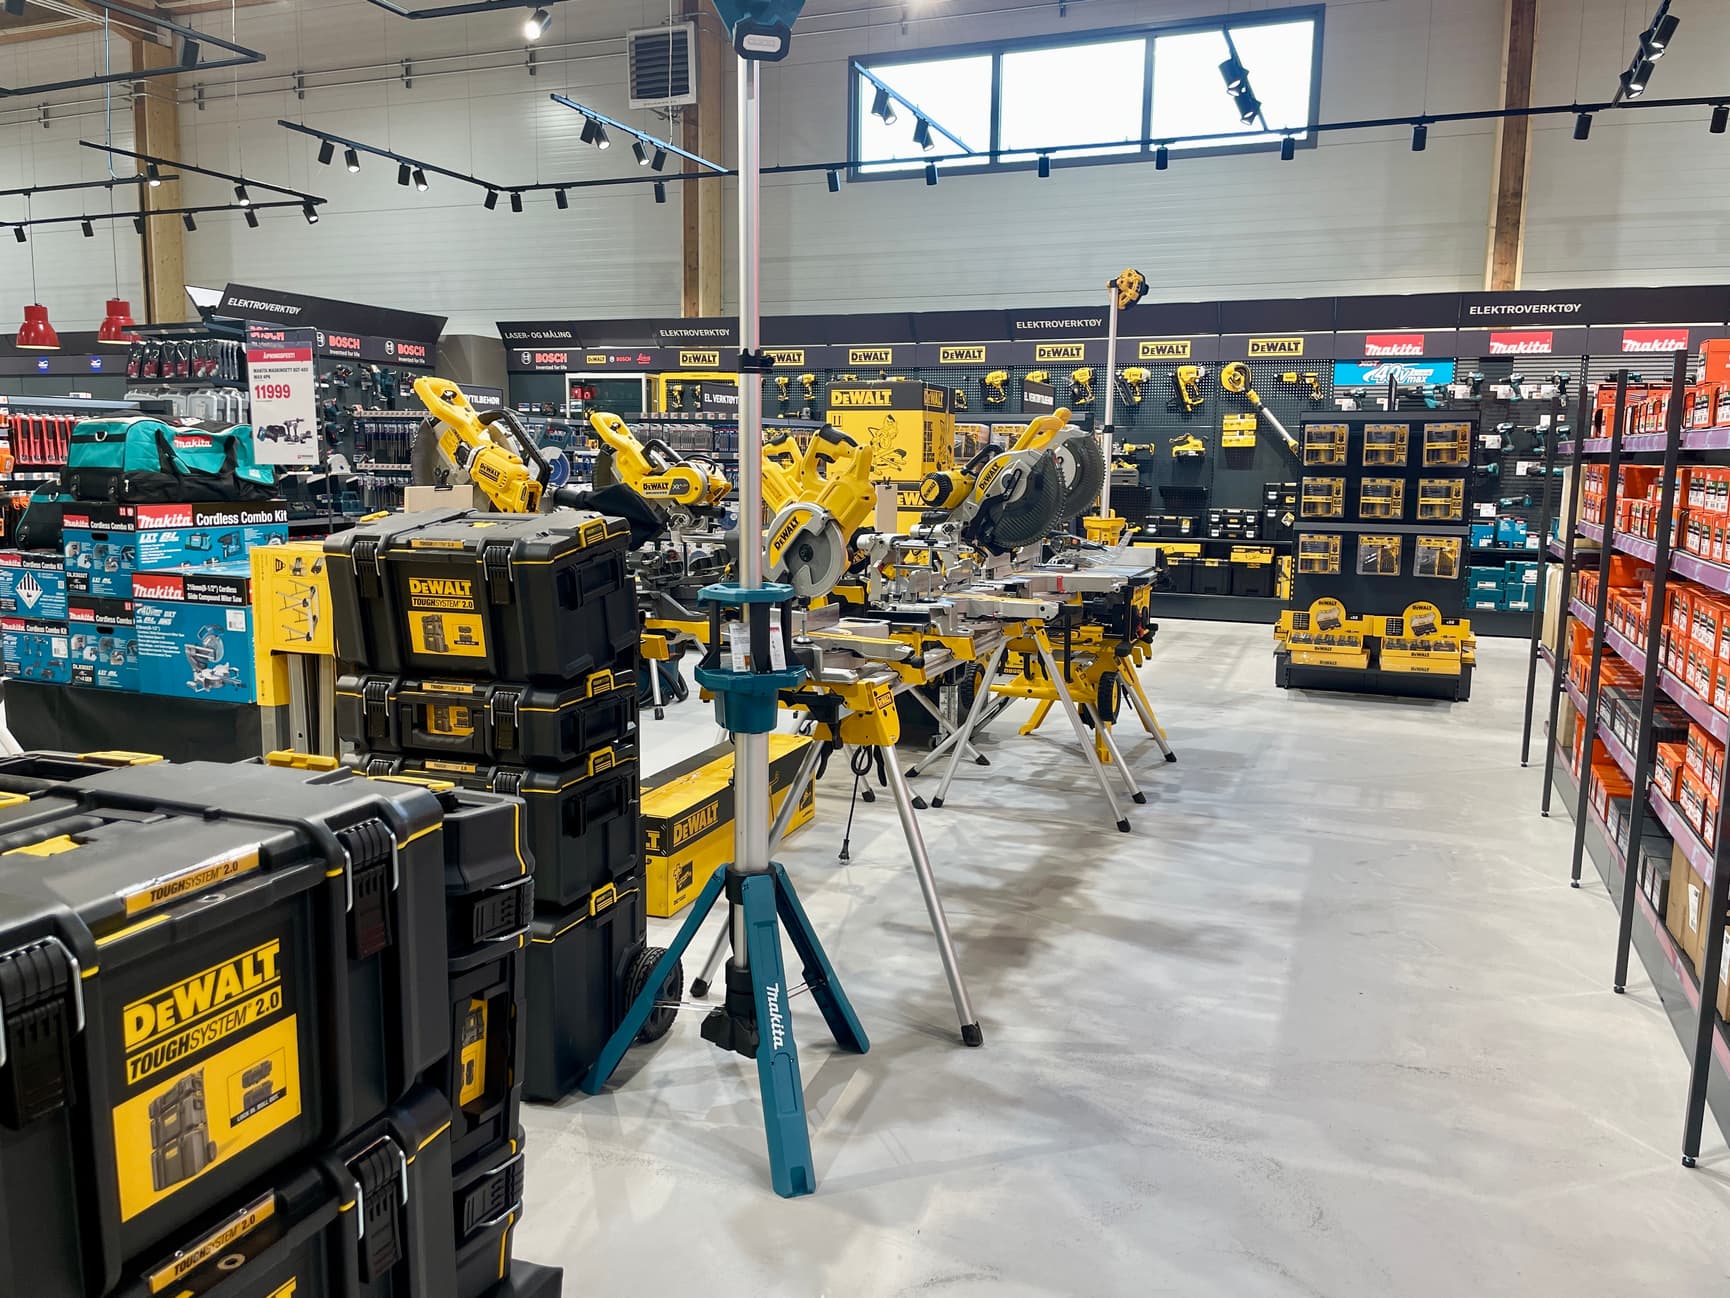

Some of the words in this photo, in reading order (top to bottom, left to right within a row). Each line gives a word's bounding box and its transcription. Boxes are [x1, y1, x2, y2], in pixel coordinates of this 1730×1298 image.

[227, 297, 301, 315] ELEKTROVERKTØY
[1469, 302, 1581, 315] ELEKTROVERKTØY
[1016, 319, 1102, 329] ELEKTROVERKTØY
[543, 330, 572, 338] MÅLING
[659, 329, 730, 337] ELEKTROVERKTØY
[329, 335, 361, 350] BOSCH
[1252, 341, 1301, 352] DEWALT
[1365, 342, 1424, 356] makita
[1490, 339, 1552, 354] makita
[1623, 337, 1689, 352] makita
[397, 343, 425, 357] BOSCH
[942, 349, 983, 360] DEWALT
[1038, 347, 1082, 357] DEWALT
[1142, 344, 1188, 355] DEWALT
[535, 353, 567, 363] BOSCH
[681, 354, 717, 364] DEWALT
[851, 351, 890, 362] DEWALT
[254, 384, 291, 399] 11999
[831, 391, 892, 405] DEWALT
[173, 439, 212, 449] makita
[979, 462, 1001, 490] DEWALT
[643, 482, 669, 490] DEWALT
[63, 519, 90, 529] makita
[137, 514, 193, 528] makita
[196, 512, 239, 526] Cordless
[240, 511, 273, 524] Combo
[274, 509, 288, 522] Kit
[90, 521, 111, 530] Cordless
[111, 522, 127, 530] Combo
[127, 523, 135, 531] Kit
[774, 516, 799, 551] DEWALT
[22, 561, 42, 569] Cordless
[41, 562, 57, 570] Combo
[132, 584, 185, 600] makita
[409, 579, 472, 596] DEWALT
[413, 598, 461, 608] TOUGHSYSTEM
[462, 600, 473, 609] 2.0
[68, 611, 95, 622] makita
[95, 614, 116, 624] Cordless
[116, 615, 133, 625] Combo
[26, 625, 45, 633] Cordless
[45, 626, 60, 634] Combo
[674, 802, 719, 846] DEWALT
[150, 870, 220, 902] TOUGHSYSTEM
[223, 861, 238, 875] 2.0
[124, 942, 281, 1049] DEWALT
[766, 982, 784, 1051] makita
[130, 1004, 250, 1080] TOUGHSYSTEM
[256, 991, 279, 1018] 2.0
[174, 1227, 238, 1276] TOUGHSYSTEM
[241, 1214, 256, 1231] 2.0
